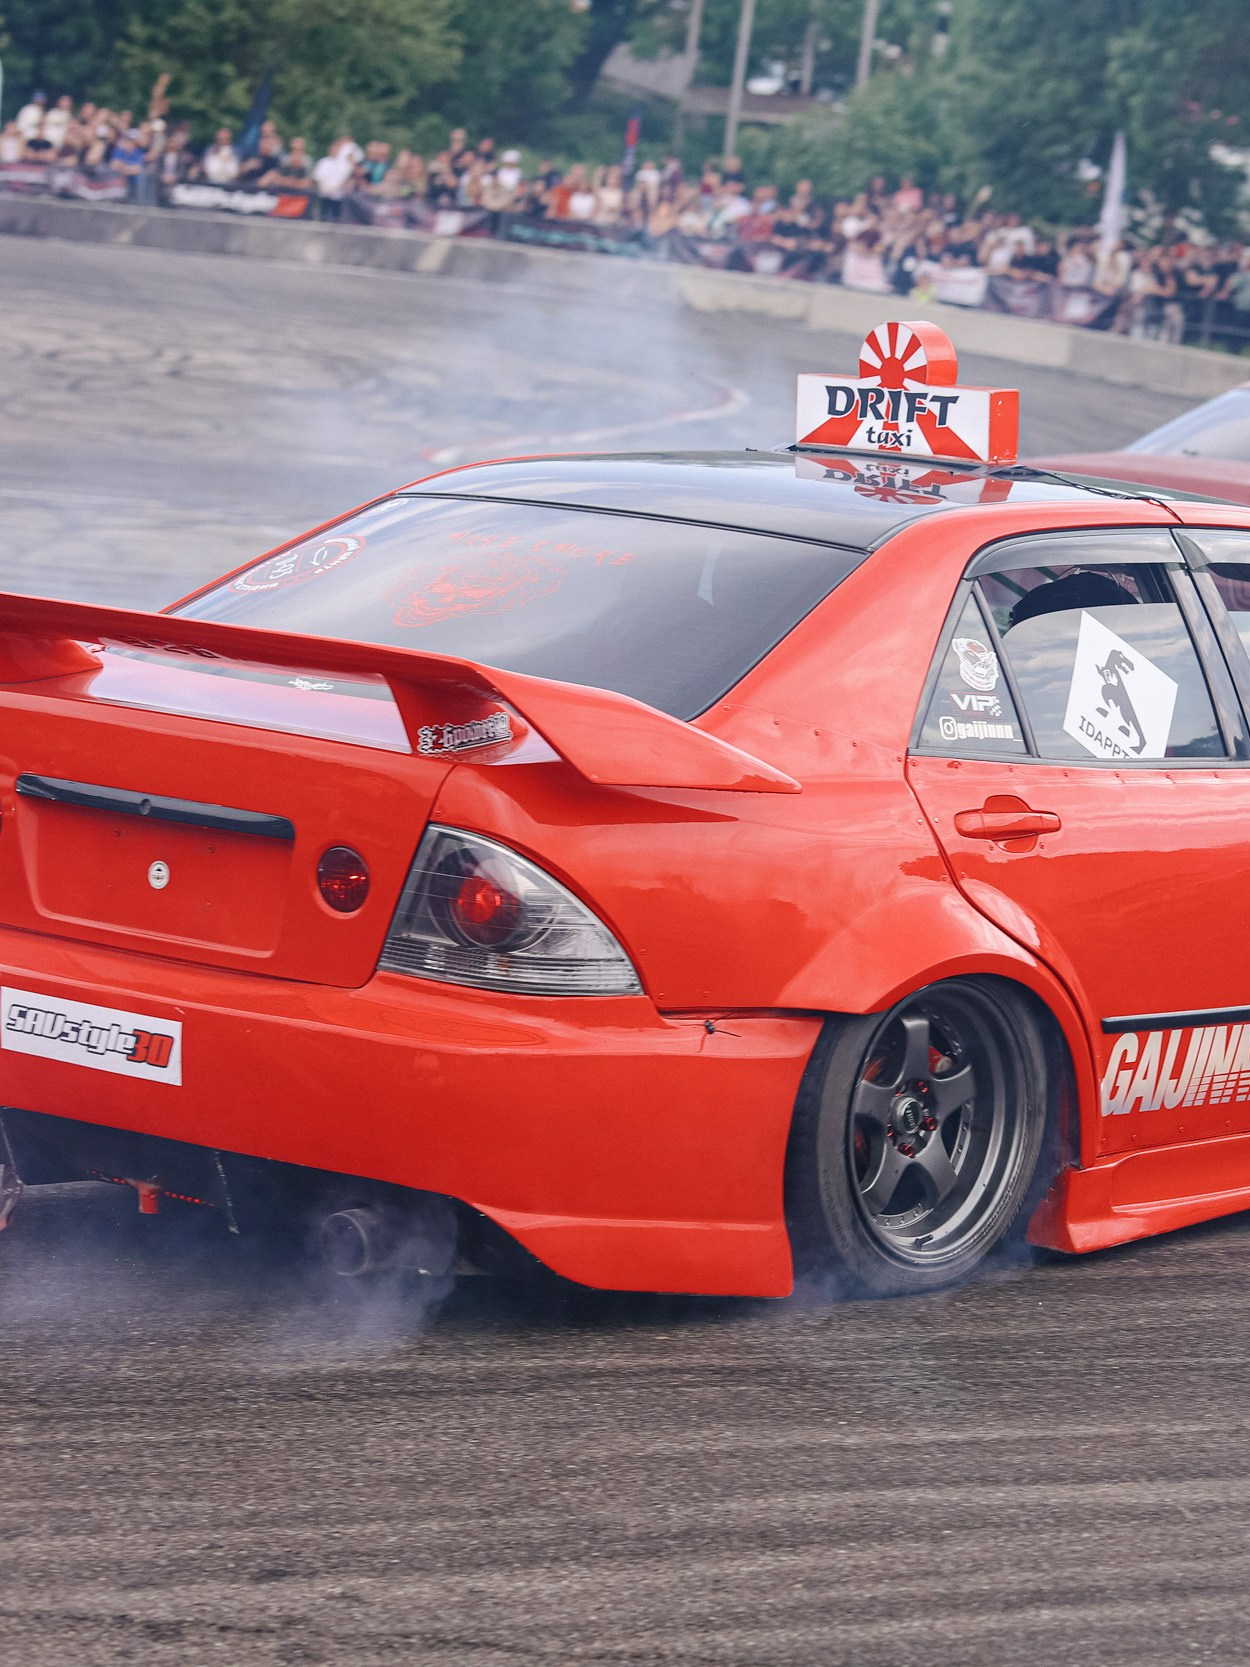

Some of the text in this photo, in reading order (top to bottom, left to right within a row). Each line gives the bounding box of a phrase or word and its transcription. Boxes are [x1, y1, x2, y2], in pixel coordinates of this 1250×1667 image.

[825, 385, 960, 427] DRIFT
[866, 426, 912, 447] taxi
[950, 693, 998, 712] VIP
